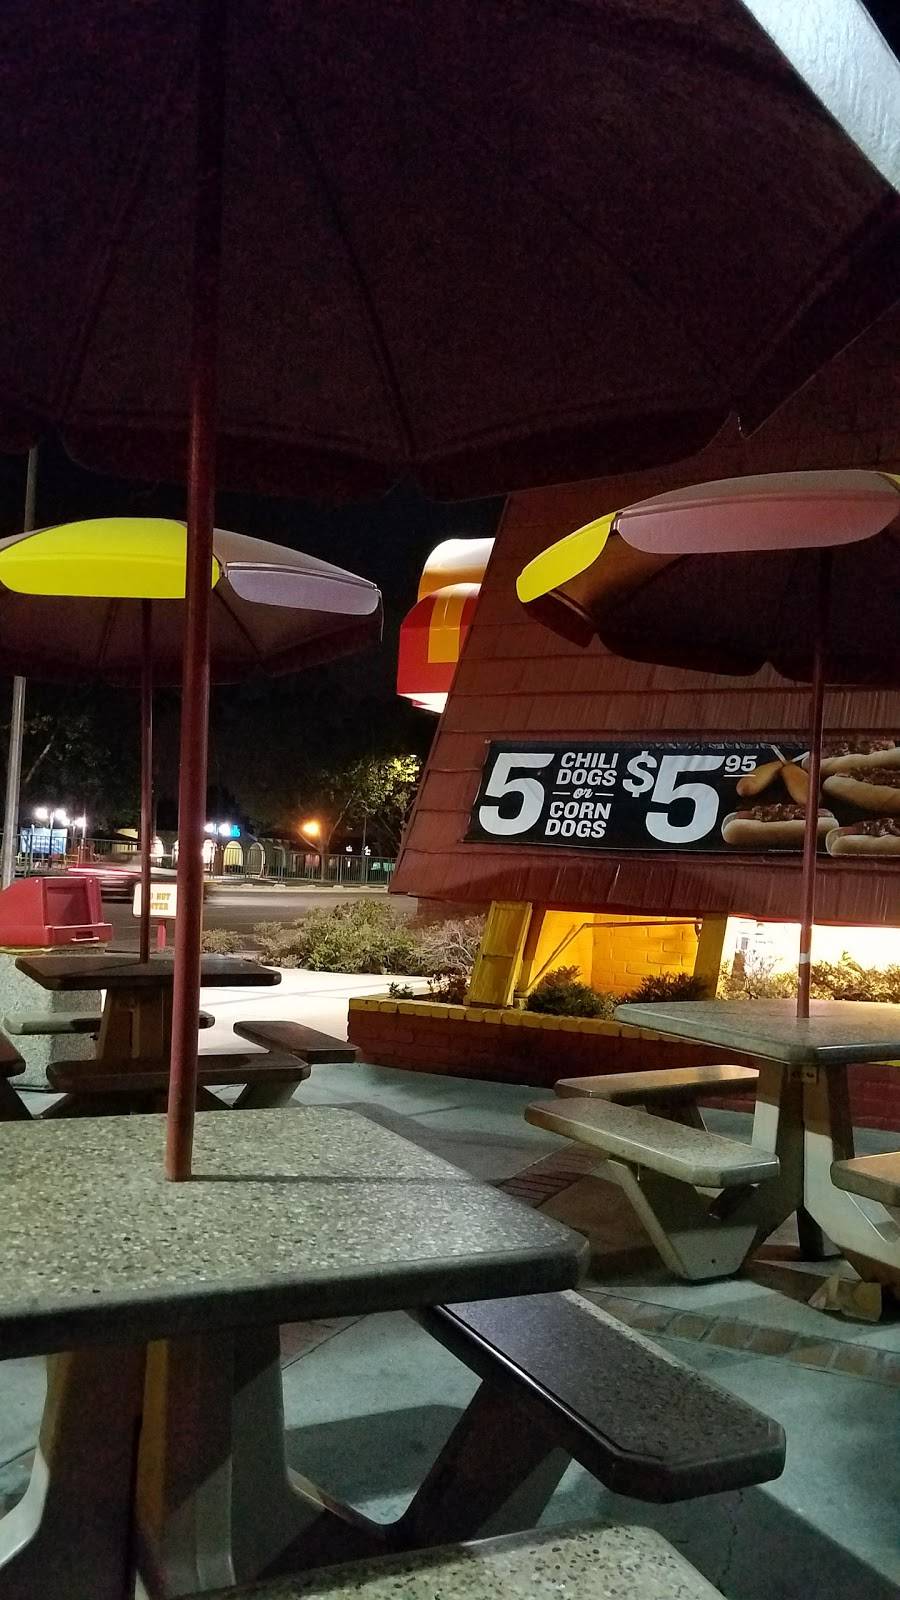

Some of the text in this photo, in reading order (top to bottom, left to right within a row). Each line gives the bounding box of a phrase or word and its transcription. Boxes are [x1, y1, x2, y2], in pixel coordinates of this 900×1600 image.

[560, 752, 619, 769] CHILI
[556, 768, 618, 786] DOGS
[478, 753, 555, 836] 5
[572, 787, 593, 799] or
[549, 801, 612, 820] CORN
[544, 819, 607, 838] DOGS
